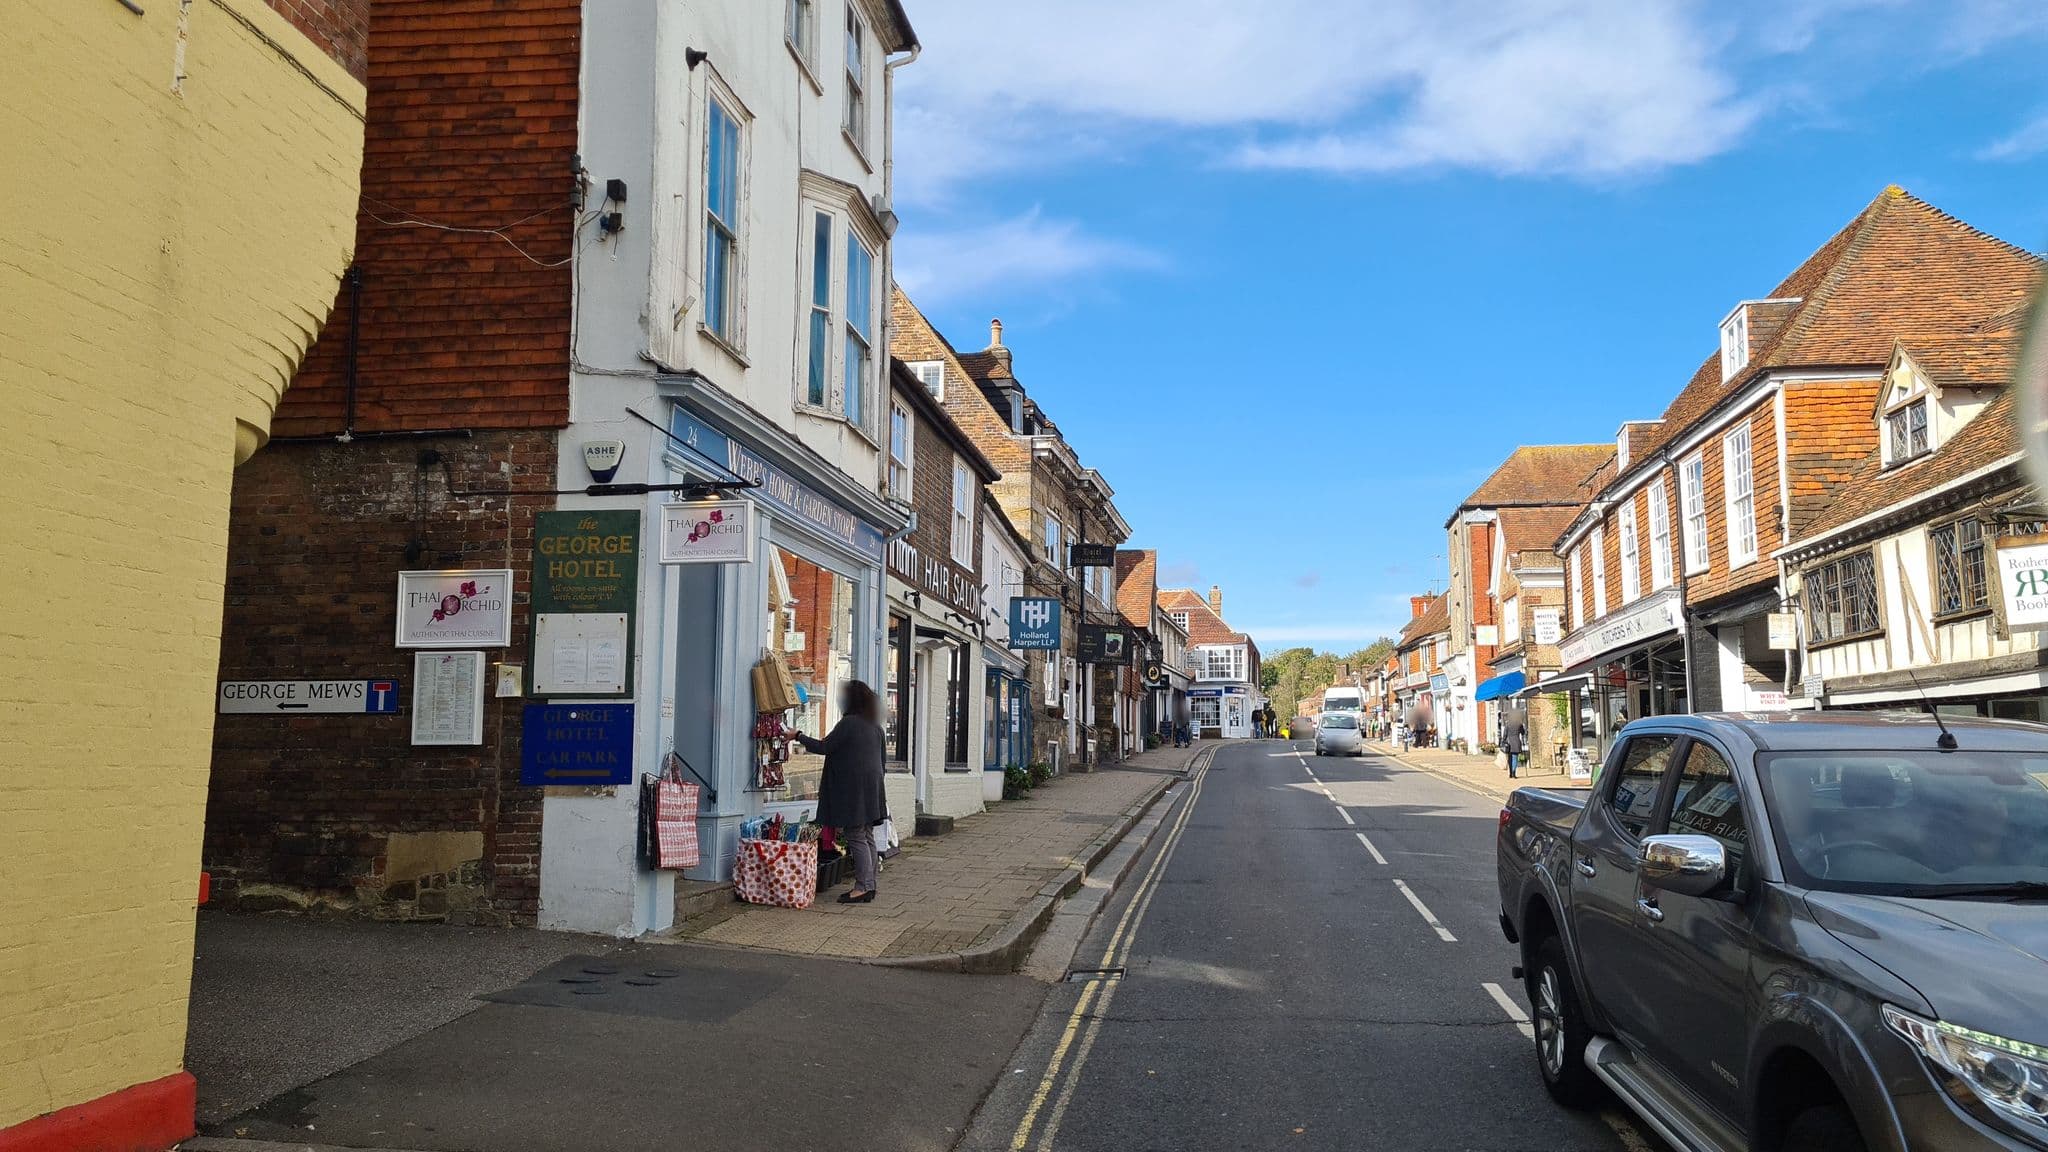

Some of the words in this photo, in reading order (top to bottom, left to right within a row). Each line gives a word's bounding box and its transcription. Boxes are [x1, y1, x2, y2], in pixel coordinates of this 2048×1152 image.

[687, 426, 698, 447] 24
[587, 446, 617, 455] ASHE
[768, 472, 794, 506] HOME
[794, 488, 802, 512] &
[802, 494, 833, 528] GARDEN
[833, 511, 857, 546] STORE
[577, 515, 599, 530] the
[667, 519, 694, 532] THAI
[694, 521, 744, 538] ORCHID
[539, 535, 633, 555] GEORGE
[548, 560, 622, 578] HOTEL
[924, 555, 949, 600] HAIR
[952, 573, 981, 618] SALON
[408, 592, 440, 608] THAI
[441, 594, 502, 616] ORCHID
[411, 630, 450, 639] AUTHENTIC
[450, 630, 467, 638] THAI
[1014, 639, 1040, 647] Harper
[223, 684, 296, 700] GEORGE
[308, 683, 363, 699] MEWS
[544, 710, 614, 722] GEORGE
[547, 728, 609, 741] HOTEL
[536, 751, 570, 764] CAR
[576, 751, 617, 763] PARK
